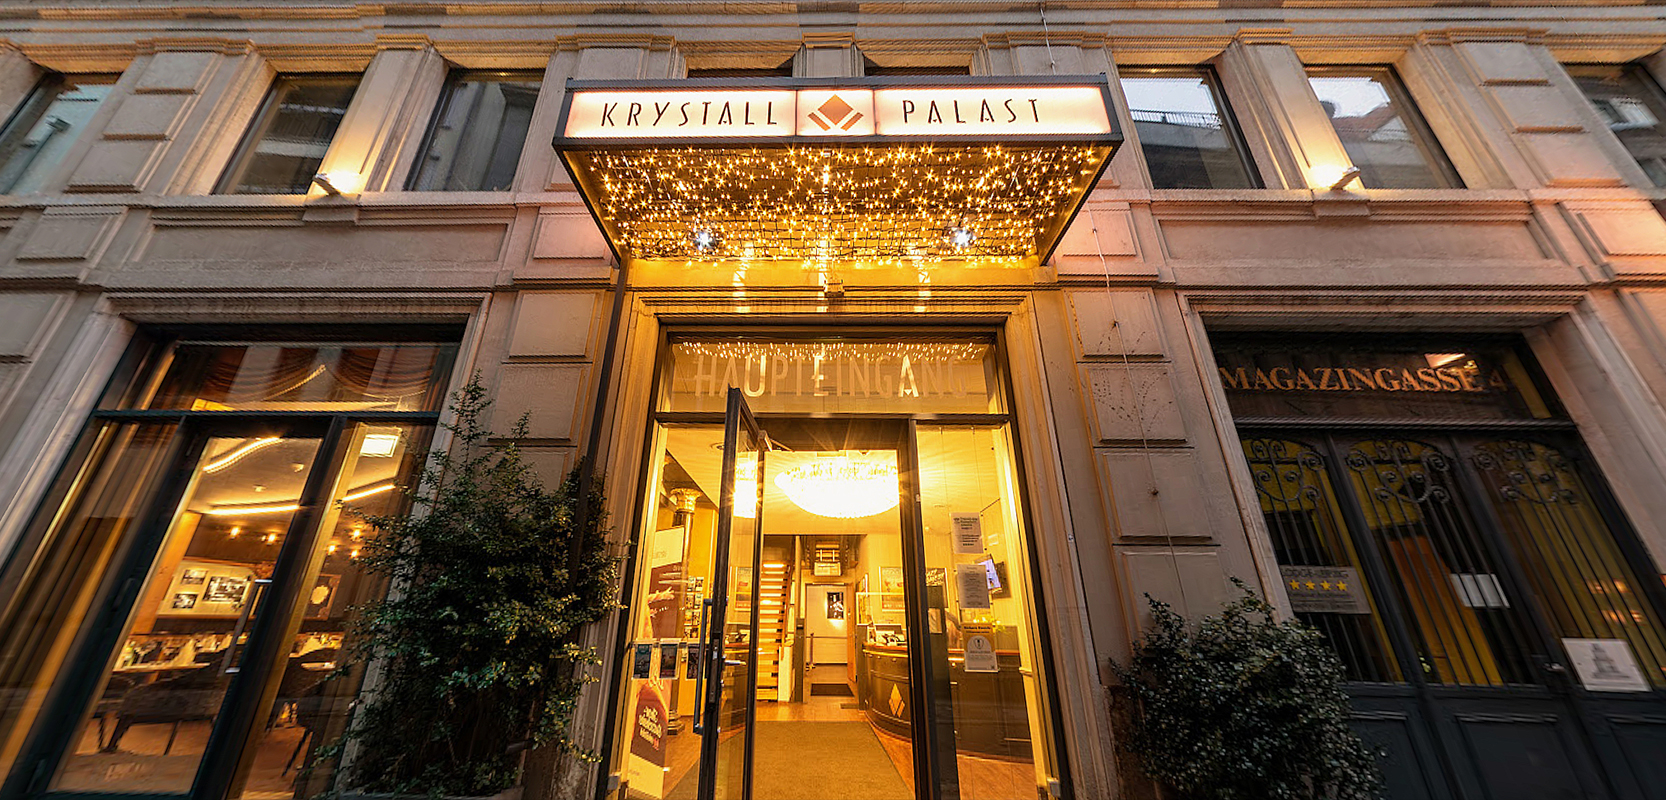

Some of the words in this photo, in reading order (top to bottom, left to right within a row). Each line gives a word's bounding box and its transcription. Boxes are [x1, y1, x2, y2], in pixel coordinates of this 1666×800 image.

[600, 100, 779, 127] KRYSTALL
[901, 97, 1042, 124] PALAST
[693, 353, 969, 398] HAUPTEINGANG
[1218, 365, 1483, 392] MAGAZINGASSE
